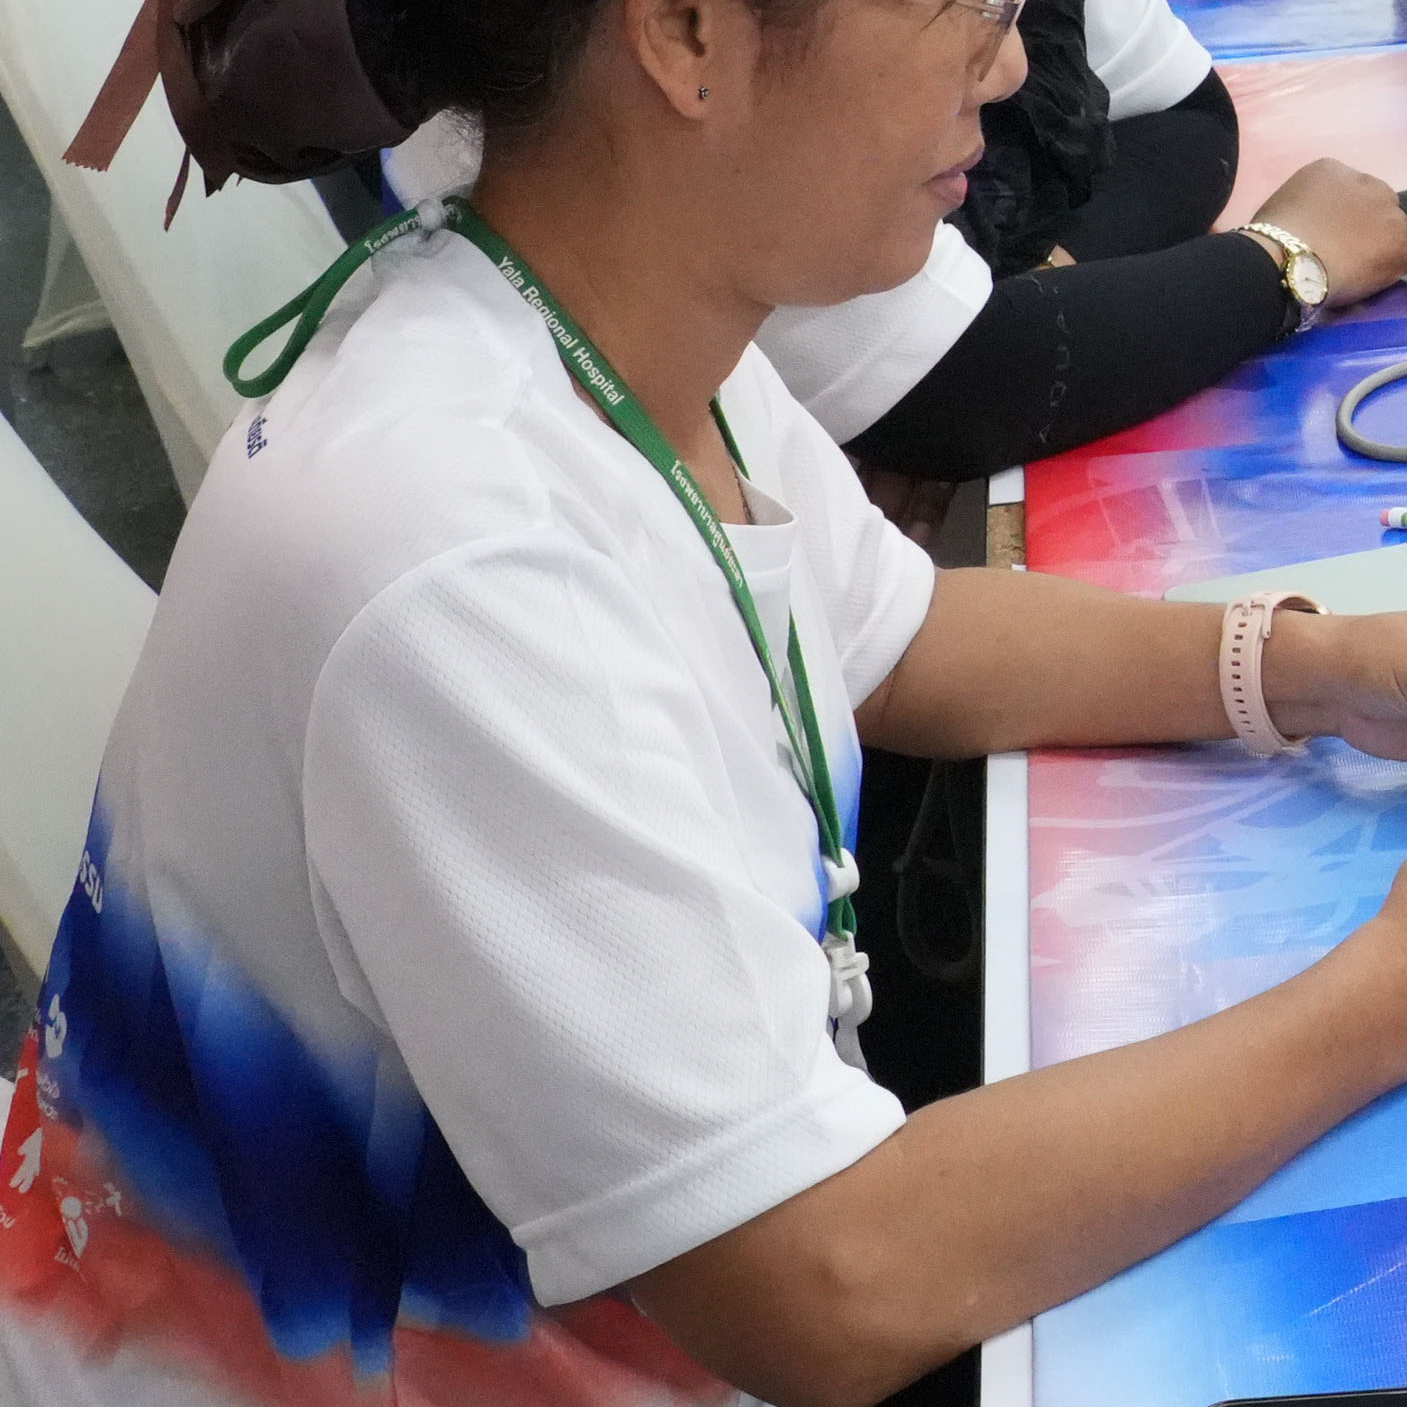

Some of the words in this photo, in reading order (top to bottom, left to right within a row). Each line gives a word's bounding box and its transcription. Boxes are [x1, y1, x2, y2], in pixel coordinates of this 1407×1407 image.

[497, 255, 525, 289] Yala
[521, 285, 576, 349] Regional
[572, 345, 625, 407] Hospital
